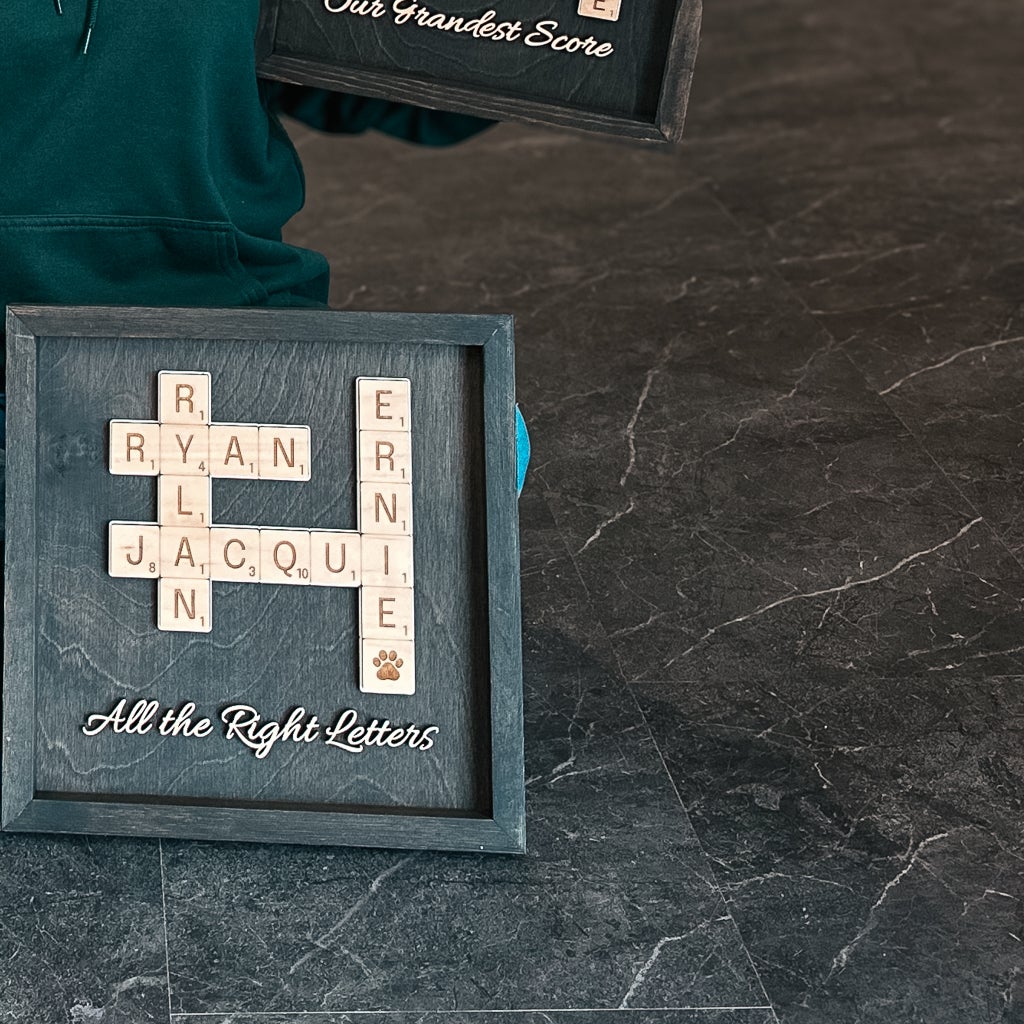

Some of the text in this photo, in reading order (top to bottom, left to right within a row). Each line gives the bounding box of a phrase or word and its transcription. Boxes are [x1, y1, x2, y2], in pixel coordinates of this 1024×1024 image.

[524, 20, 615, 59] Score
[125, 432, 306, 475] RYAN
[172, 382, 206, 628] RYLAN
[373, 388, 410, 636] ERNIE
[125, 534, 408, 585] JACQUI
[82, 698, 440, 759] All the Right Letters
